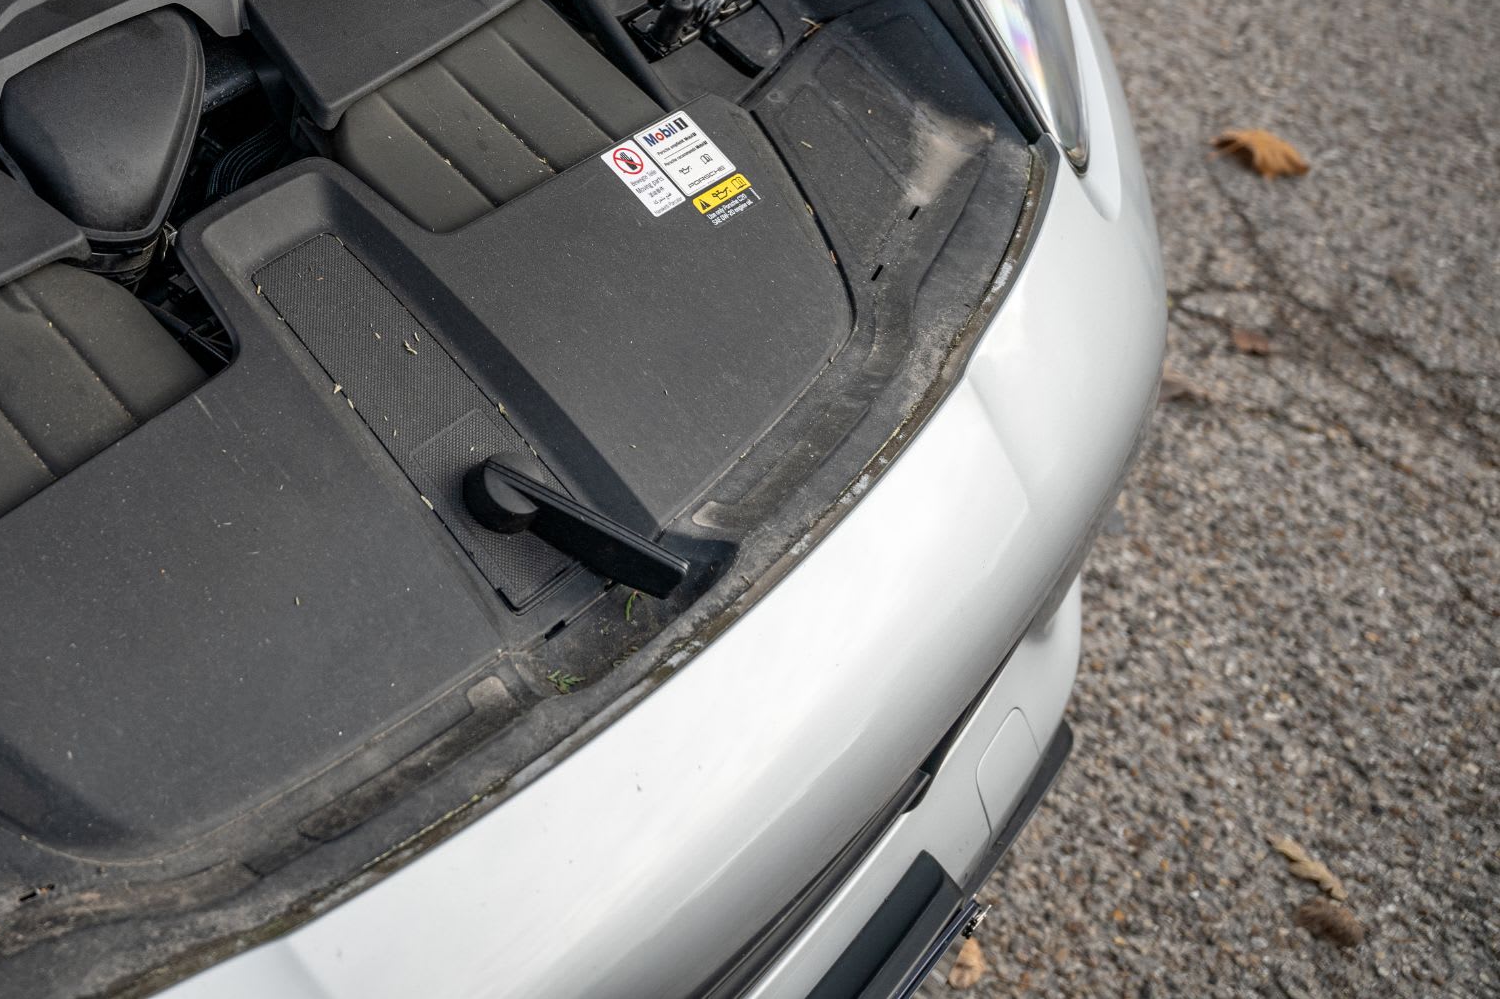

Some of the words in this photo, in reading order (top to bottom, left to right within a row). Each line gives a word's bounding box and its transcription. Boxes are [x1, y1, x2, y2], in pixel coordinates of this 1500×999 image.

[642, 123, 678, 147] Mobil
[674, 118, 687, 130] 1
[635, 183, 654, 194] Moving
[652, 177, 665, 186] parts
[688, 165, 726, 188] PORSCHE
[722, 199, 740, 211] Porsche
